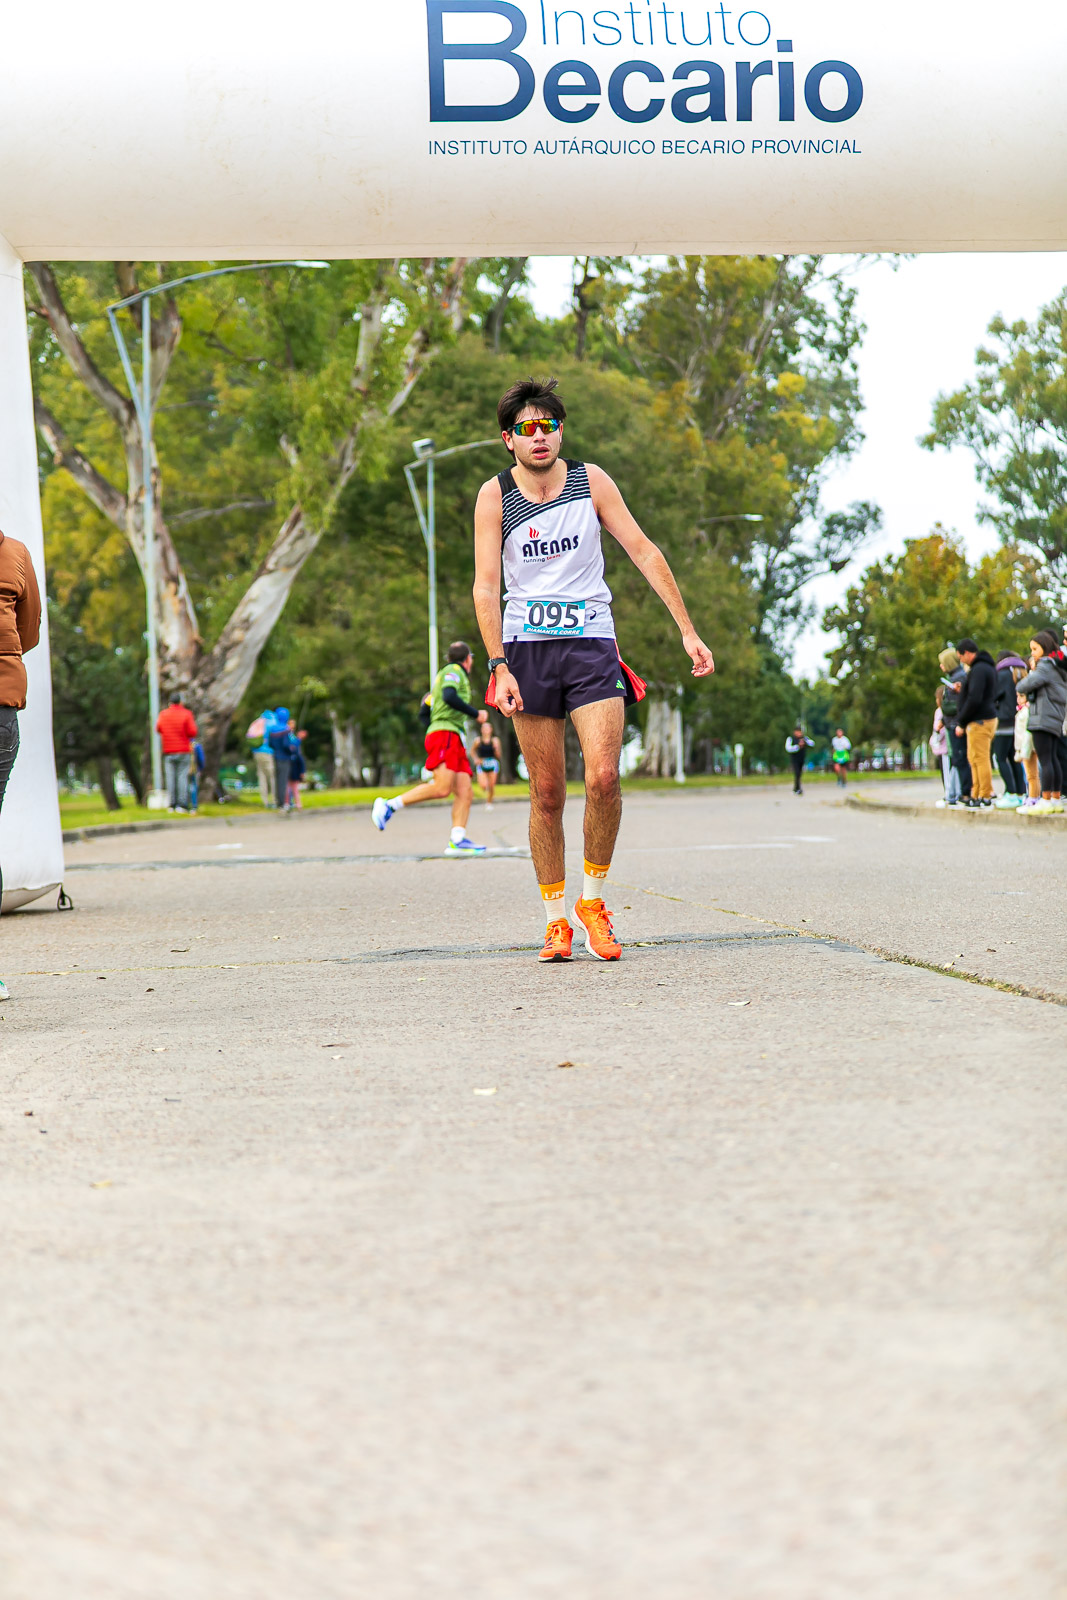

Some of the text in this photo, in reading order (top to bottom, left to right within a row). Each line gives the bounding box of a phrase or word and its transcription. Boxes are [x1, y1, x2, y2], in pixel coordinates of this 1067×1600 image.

[540, 0, 771, 46] Instituto
[427, 0, 864, 123] Becario
[428, 136, 863, 156] INSTITUTO AUTÁRQUICO BECARIO PROVINCIAL
[522, 535, 579, 557] ATENAS
[528, 602, 579, 629] 095
[526, 627, 559, 635] DIAMANTE
